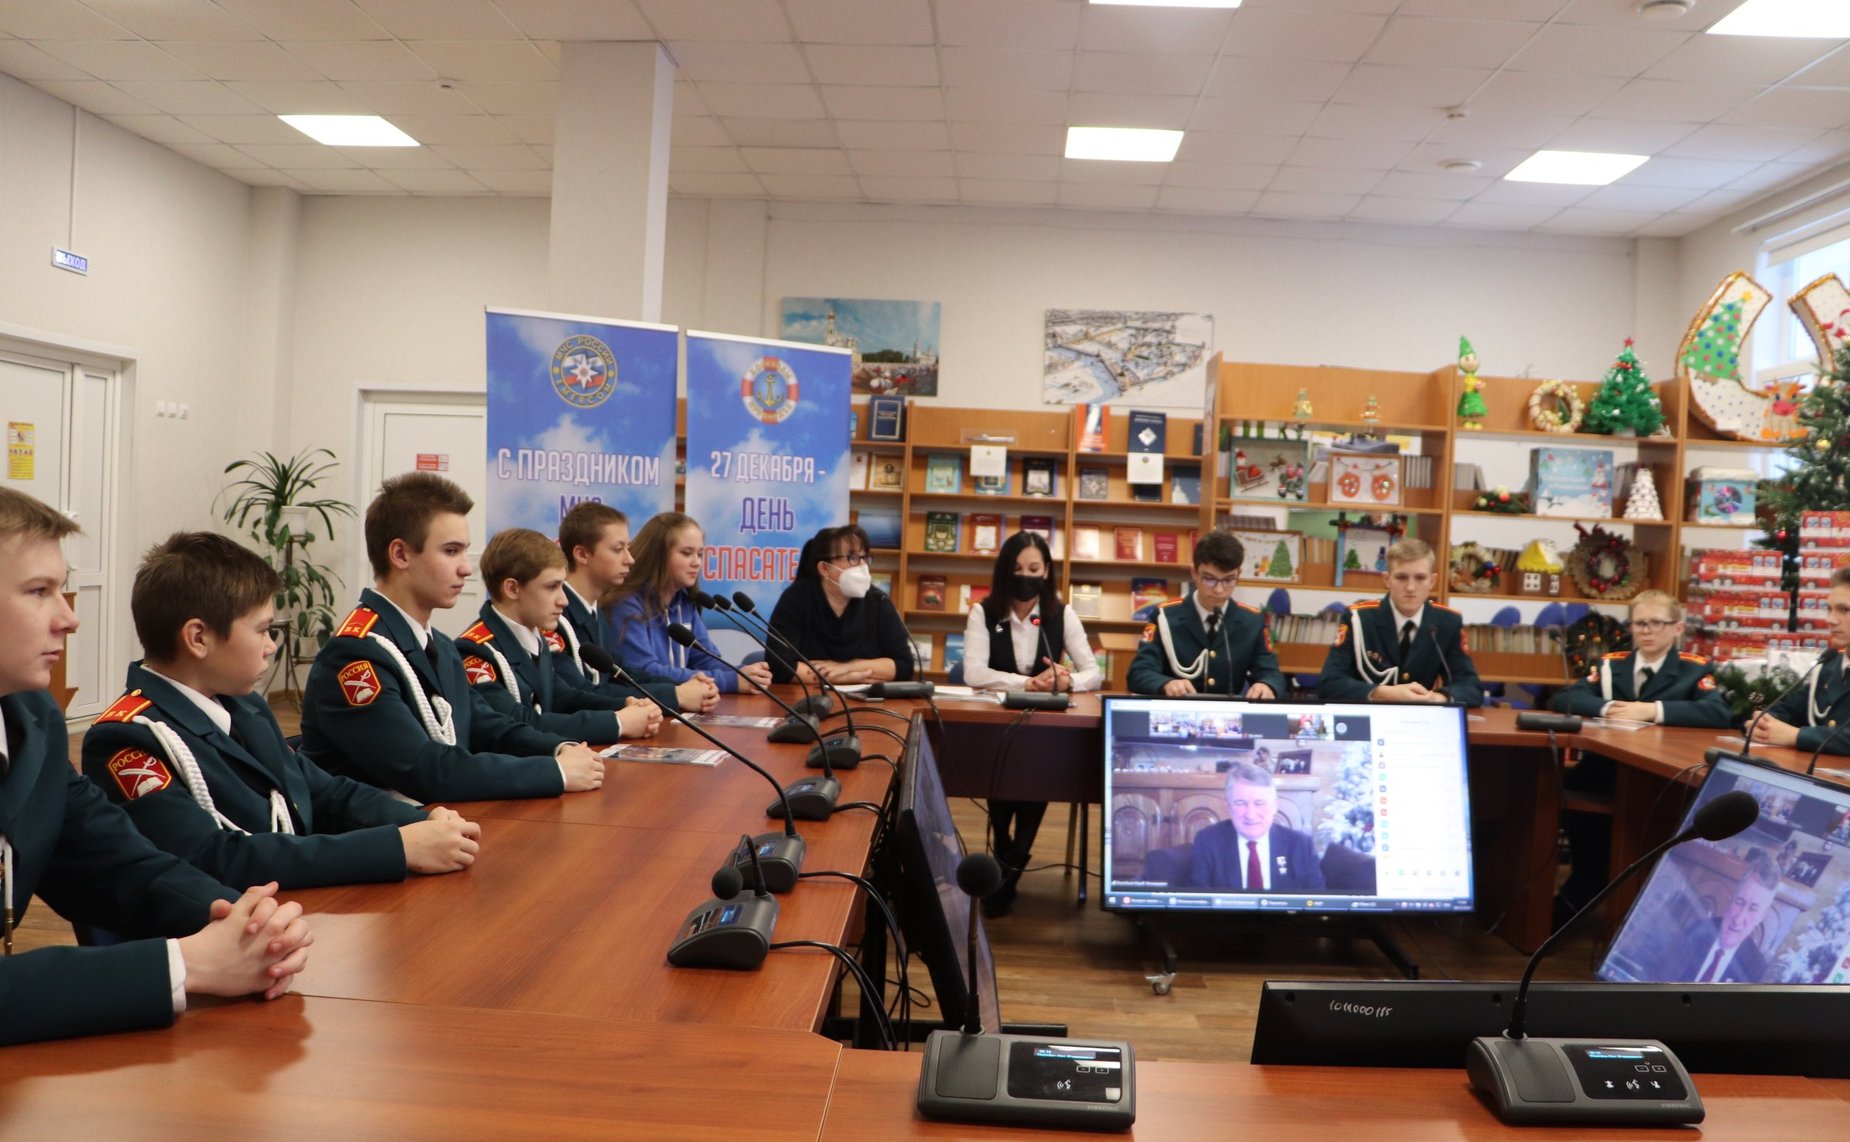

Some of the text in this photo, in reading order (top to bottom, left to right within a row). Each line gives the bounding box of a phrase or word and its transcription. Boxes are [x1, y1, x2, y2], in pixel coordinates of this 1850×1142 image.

[555, 336, 614, 365] МЧС РОССИИ
[497, 447, 661, 487] С ПРАЗДНИКОМ
[709, 450, 733, 479] 27
[735, 452, 815, 484] ДЕКАБРЯ
[739, 496, 796, 534] ДЕНЬ
[702, 544, 801, 582] СПАСАТЕ
[340, 661, 371, 682] РОССИЯ
